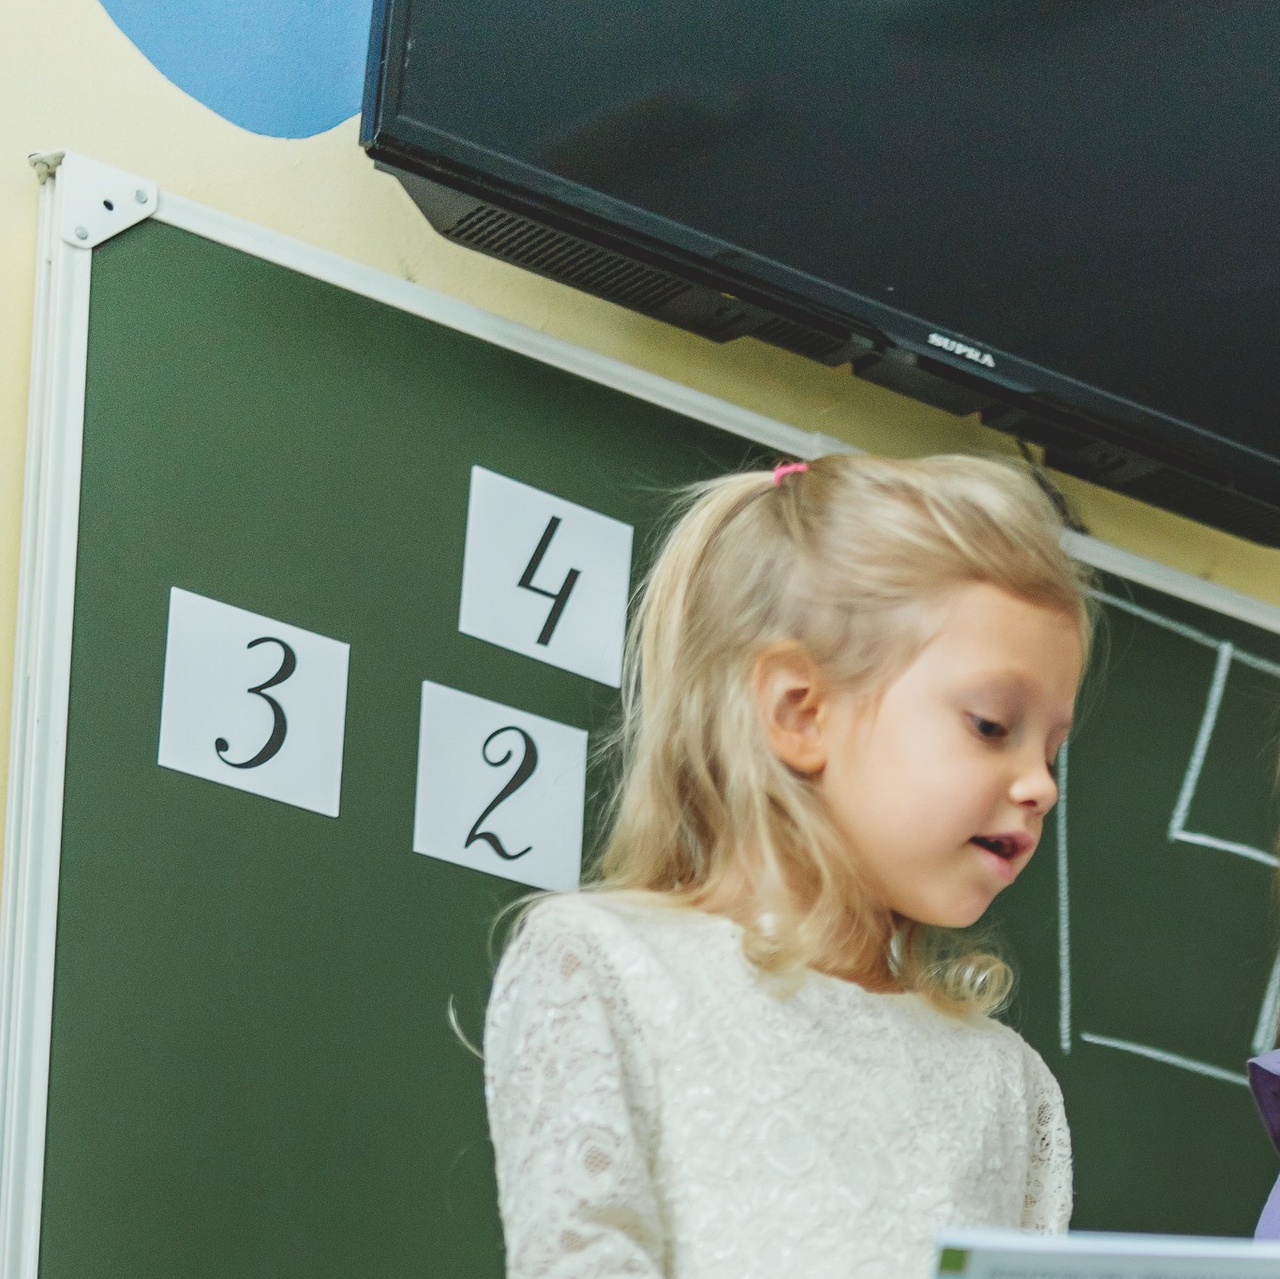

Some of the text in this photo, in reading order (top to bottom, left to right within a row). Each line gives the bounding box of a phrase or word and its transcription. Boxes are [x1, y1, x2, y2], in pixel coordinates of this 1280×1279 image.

[927, 333, 996, 368] SUPRA
[517, 516, 581, 647] 4
[214, 636, 298, 770] 3
[463, 725, 540, 861] 2
